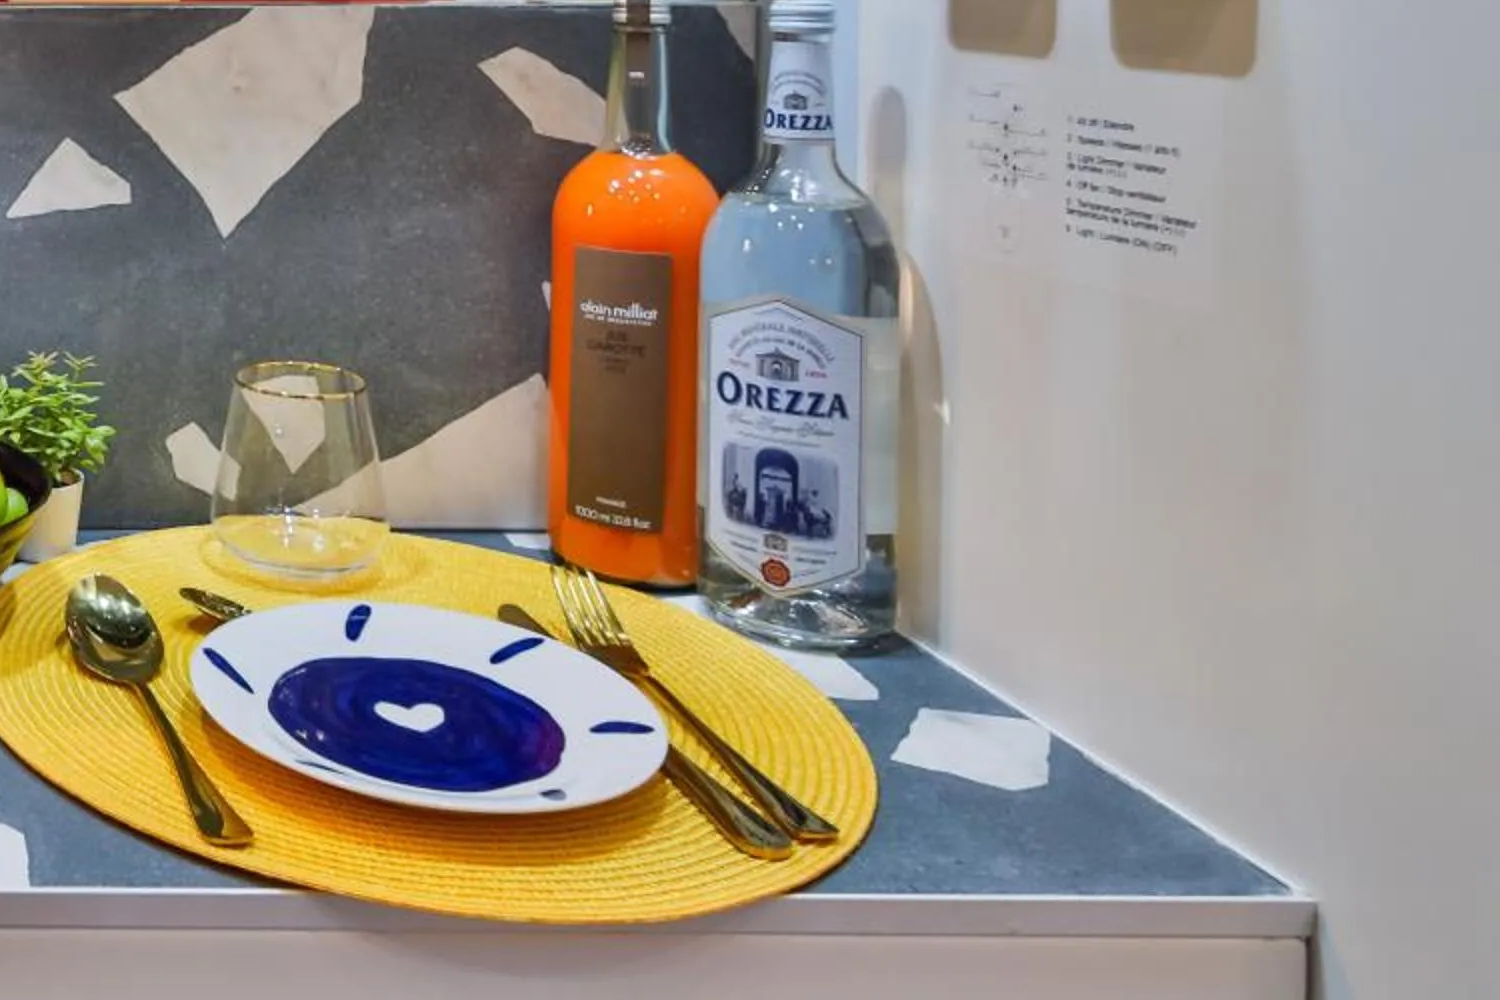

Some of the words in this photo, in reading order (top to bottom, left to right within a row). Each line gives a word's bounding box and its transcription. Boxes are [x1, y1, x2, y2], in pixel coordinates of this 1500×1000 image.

[764, 107, 834, 131] OREZZA
[579, 299, 612, 315] alain
[613, 301, 658, 321] milliat
[716, 370, 850, 421] OREZZA
